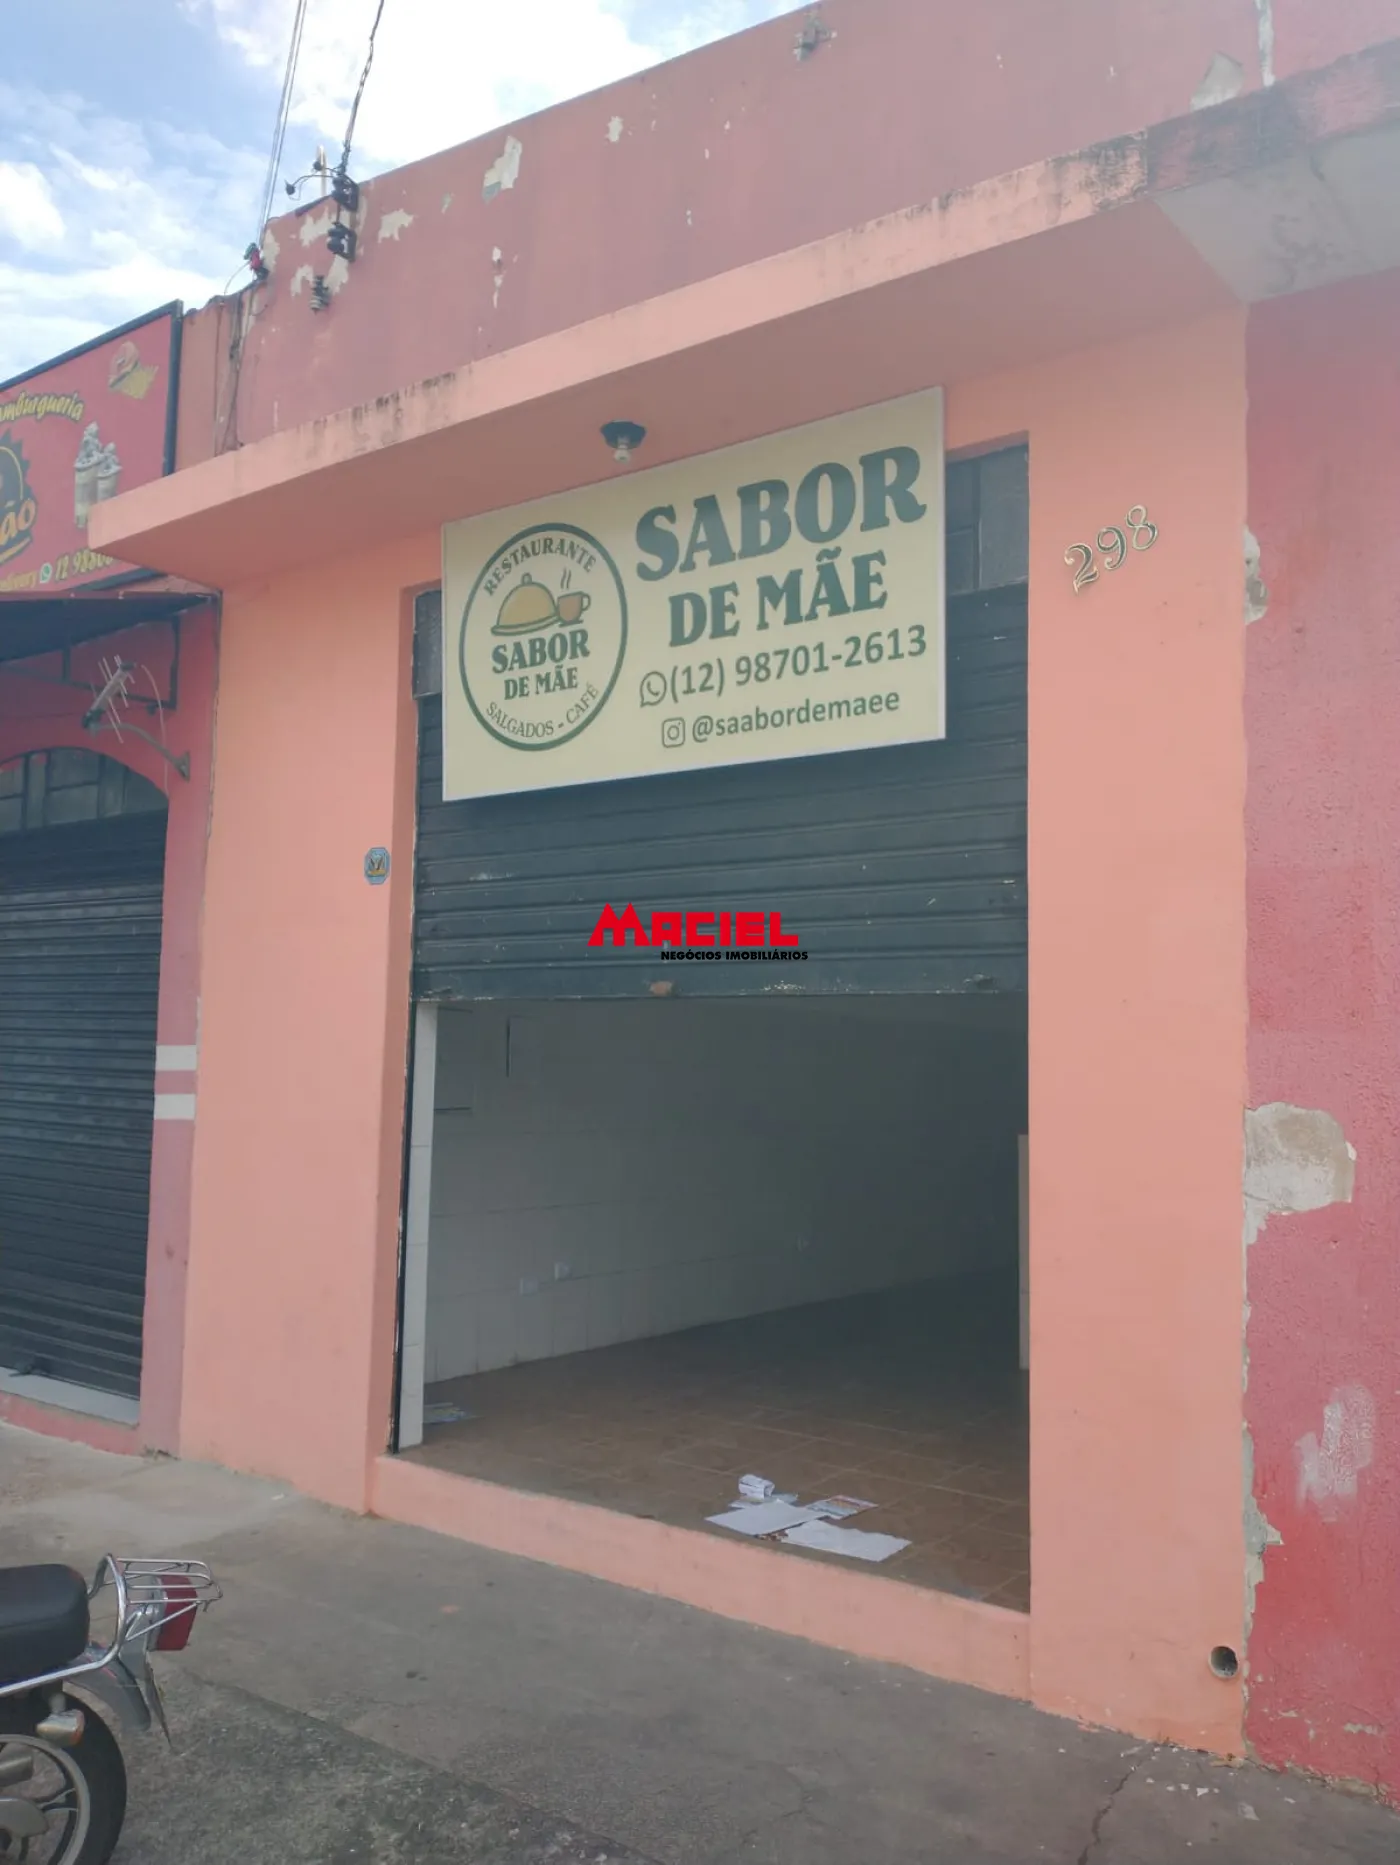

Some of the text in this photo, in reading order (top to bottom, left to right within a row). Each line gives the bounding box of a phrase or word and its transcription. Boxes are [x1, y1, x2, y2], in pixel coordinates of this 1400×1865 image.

[0, 391, 84, 421] mburgueria
[635, 446, 927, 582] SABOR
[483, 537, 597, 596] RESTAURANTE
[1064, 504, 1158, 594] 298
[668, 546, 888, 648] DE MÃE
[491, 629, 590, 674] SABOR
[670, 624, 927, 704] (12) 98701-2613
[486, 702, 554, 738] SALGADOS
[566, 682, 600, 724] CAFÉ
[504, 664, 579, 700] DE MÃE
[692, 691, 901, 743] @saabordemaee
